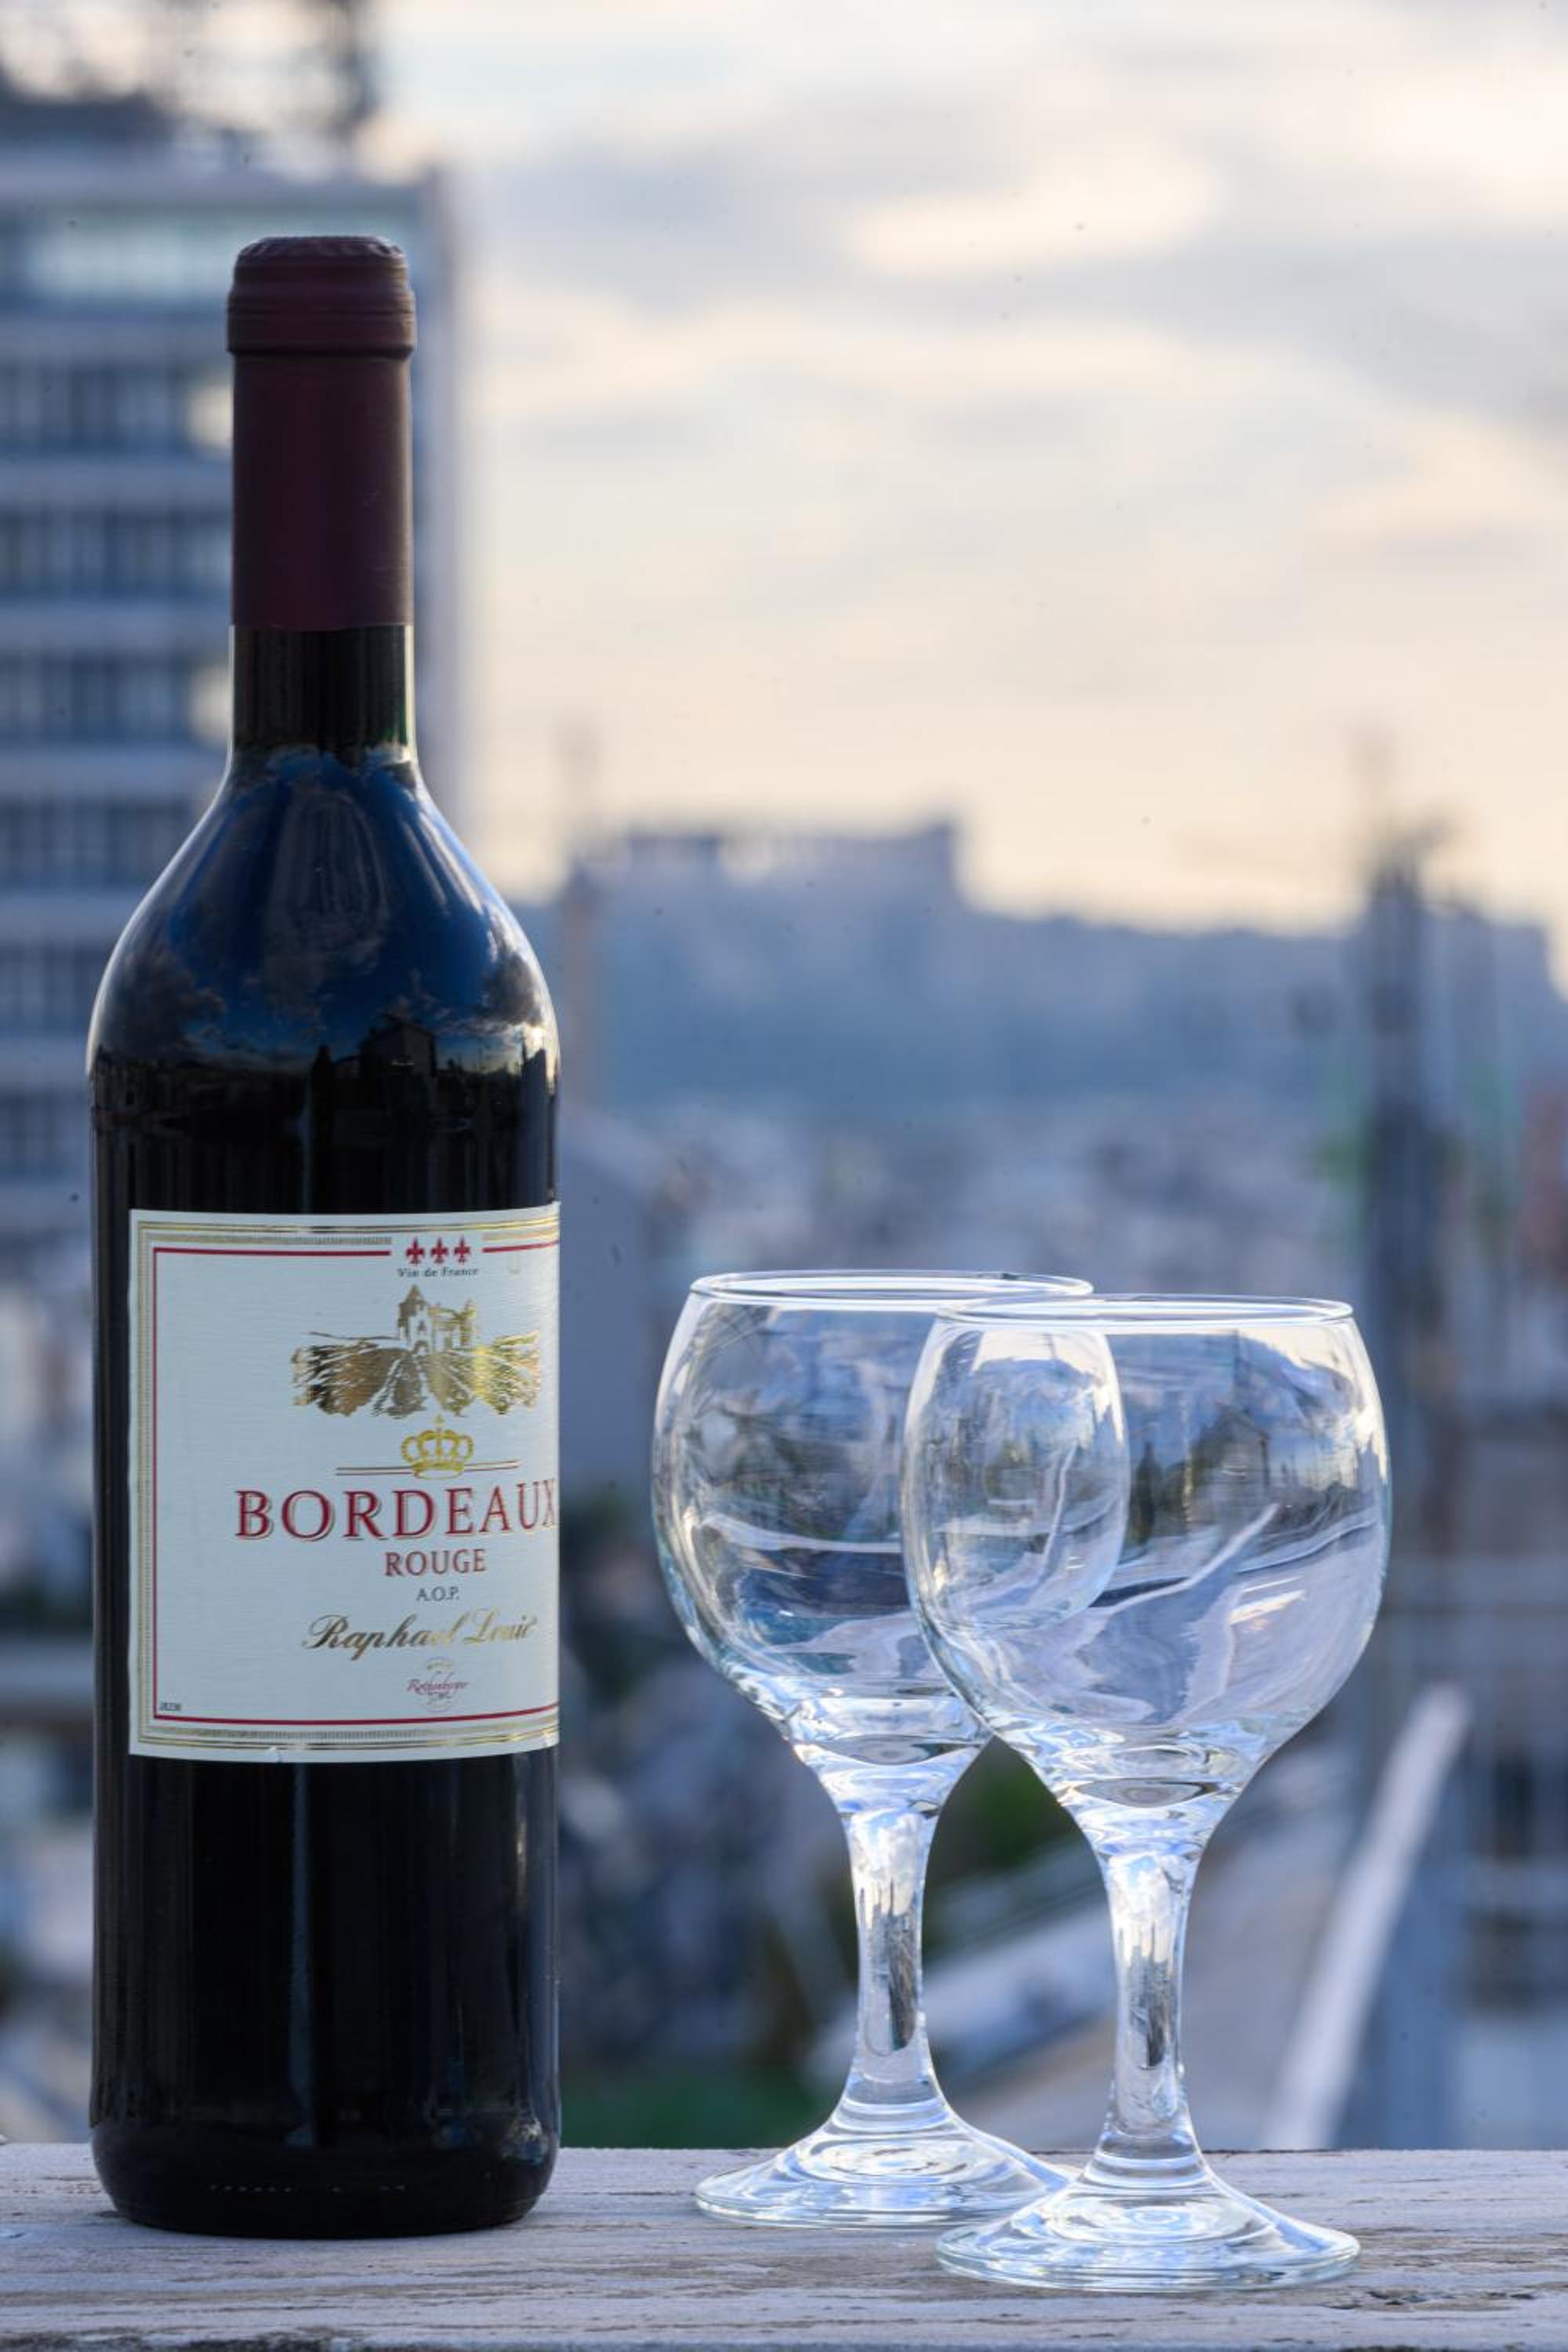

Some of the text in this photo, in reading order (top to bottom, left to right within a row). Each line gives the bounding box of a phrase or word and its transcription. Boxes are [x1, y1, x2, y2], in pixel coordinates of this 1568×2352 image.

[397, 1266, 478, 1277] Vin de France
[235, 1478, 557, 1541] BORDEAUX
[384, 1548, 486, 1577] ROUGE
[416, 1586, 460, 1602] A.O.P.
